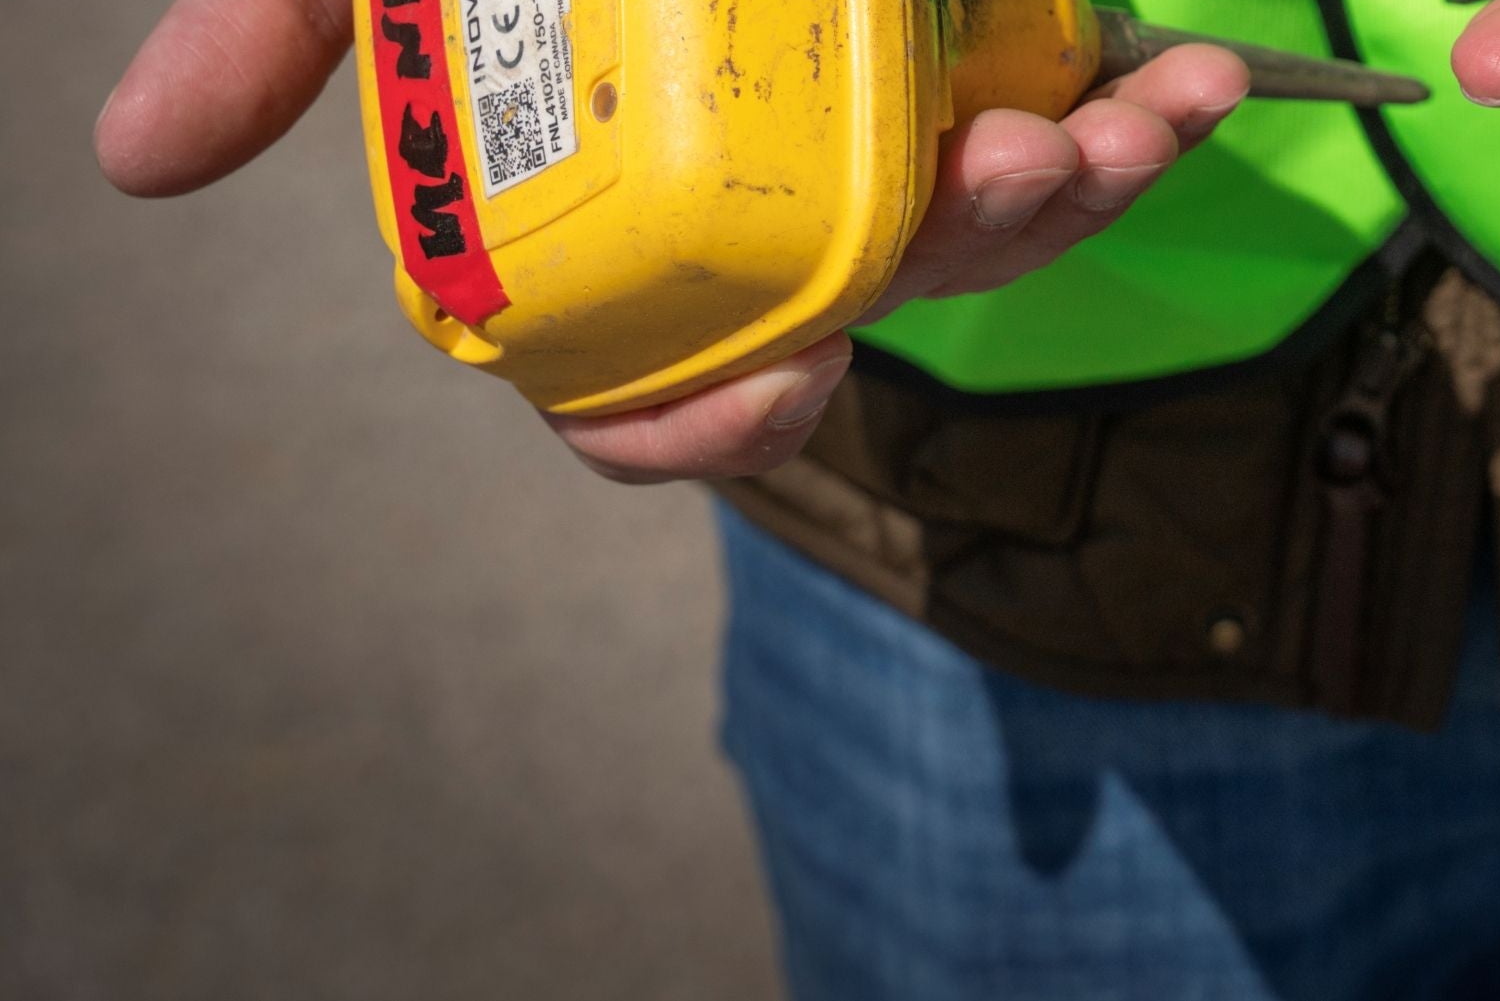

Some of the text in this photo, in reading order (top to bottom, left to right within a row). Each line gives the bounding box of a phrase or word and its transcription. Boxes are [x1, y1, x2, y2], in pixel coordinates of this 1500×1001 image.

[539, 58, 562, 153] FNL41020
[549, 21, 568, 121] MADE IN CANADA
